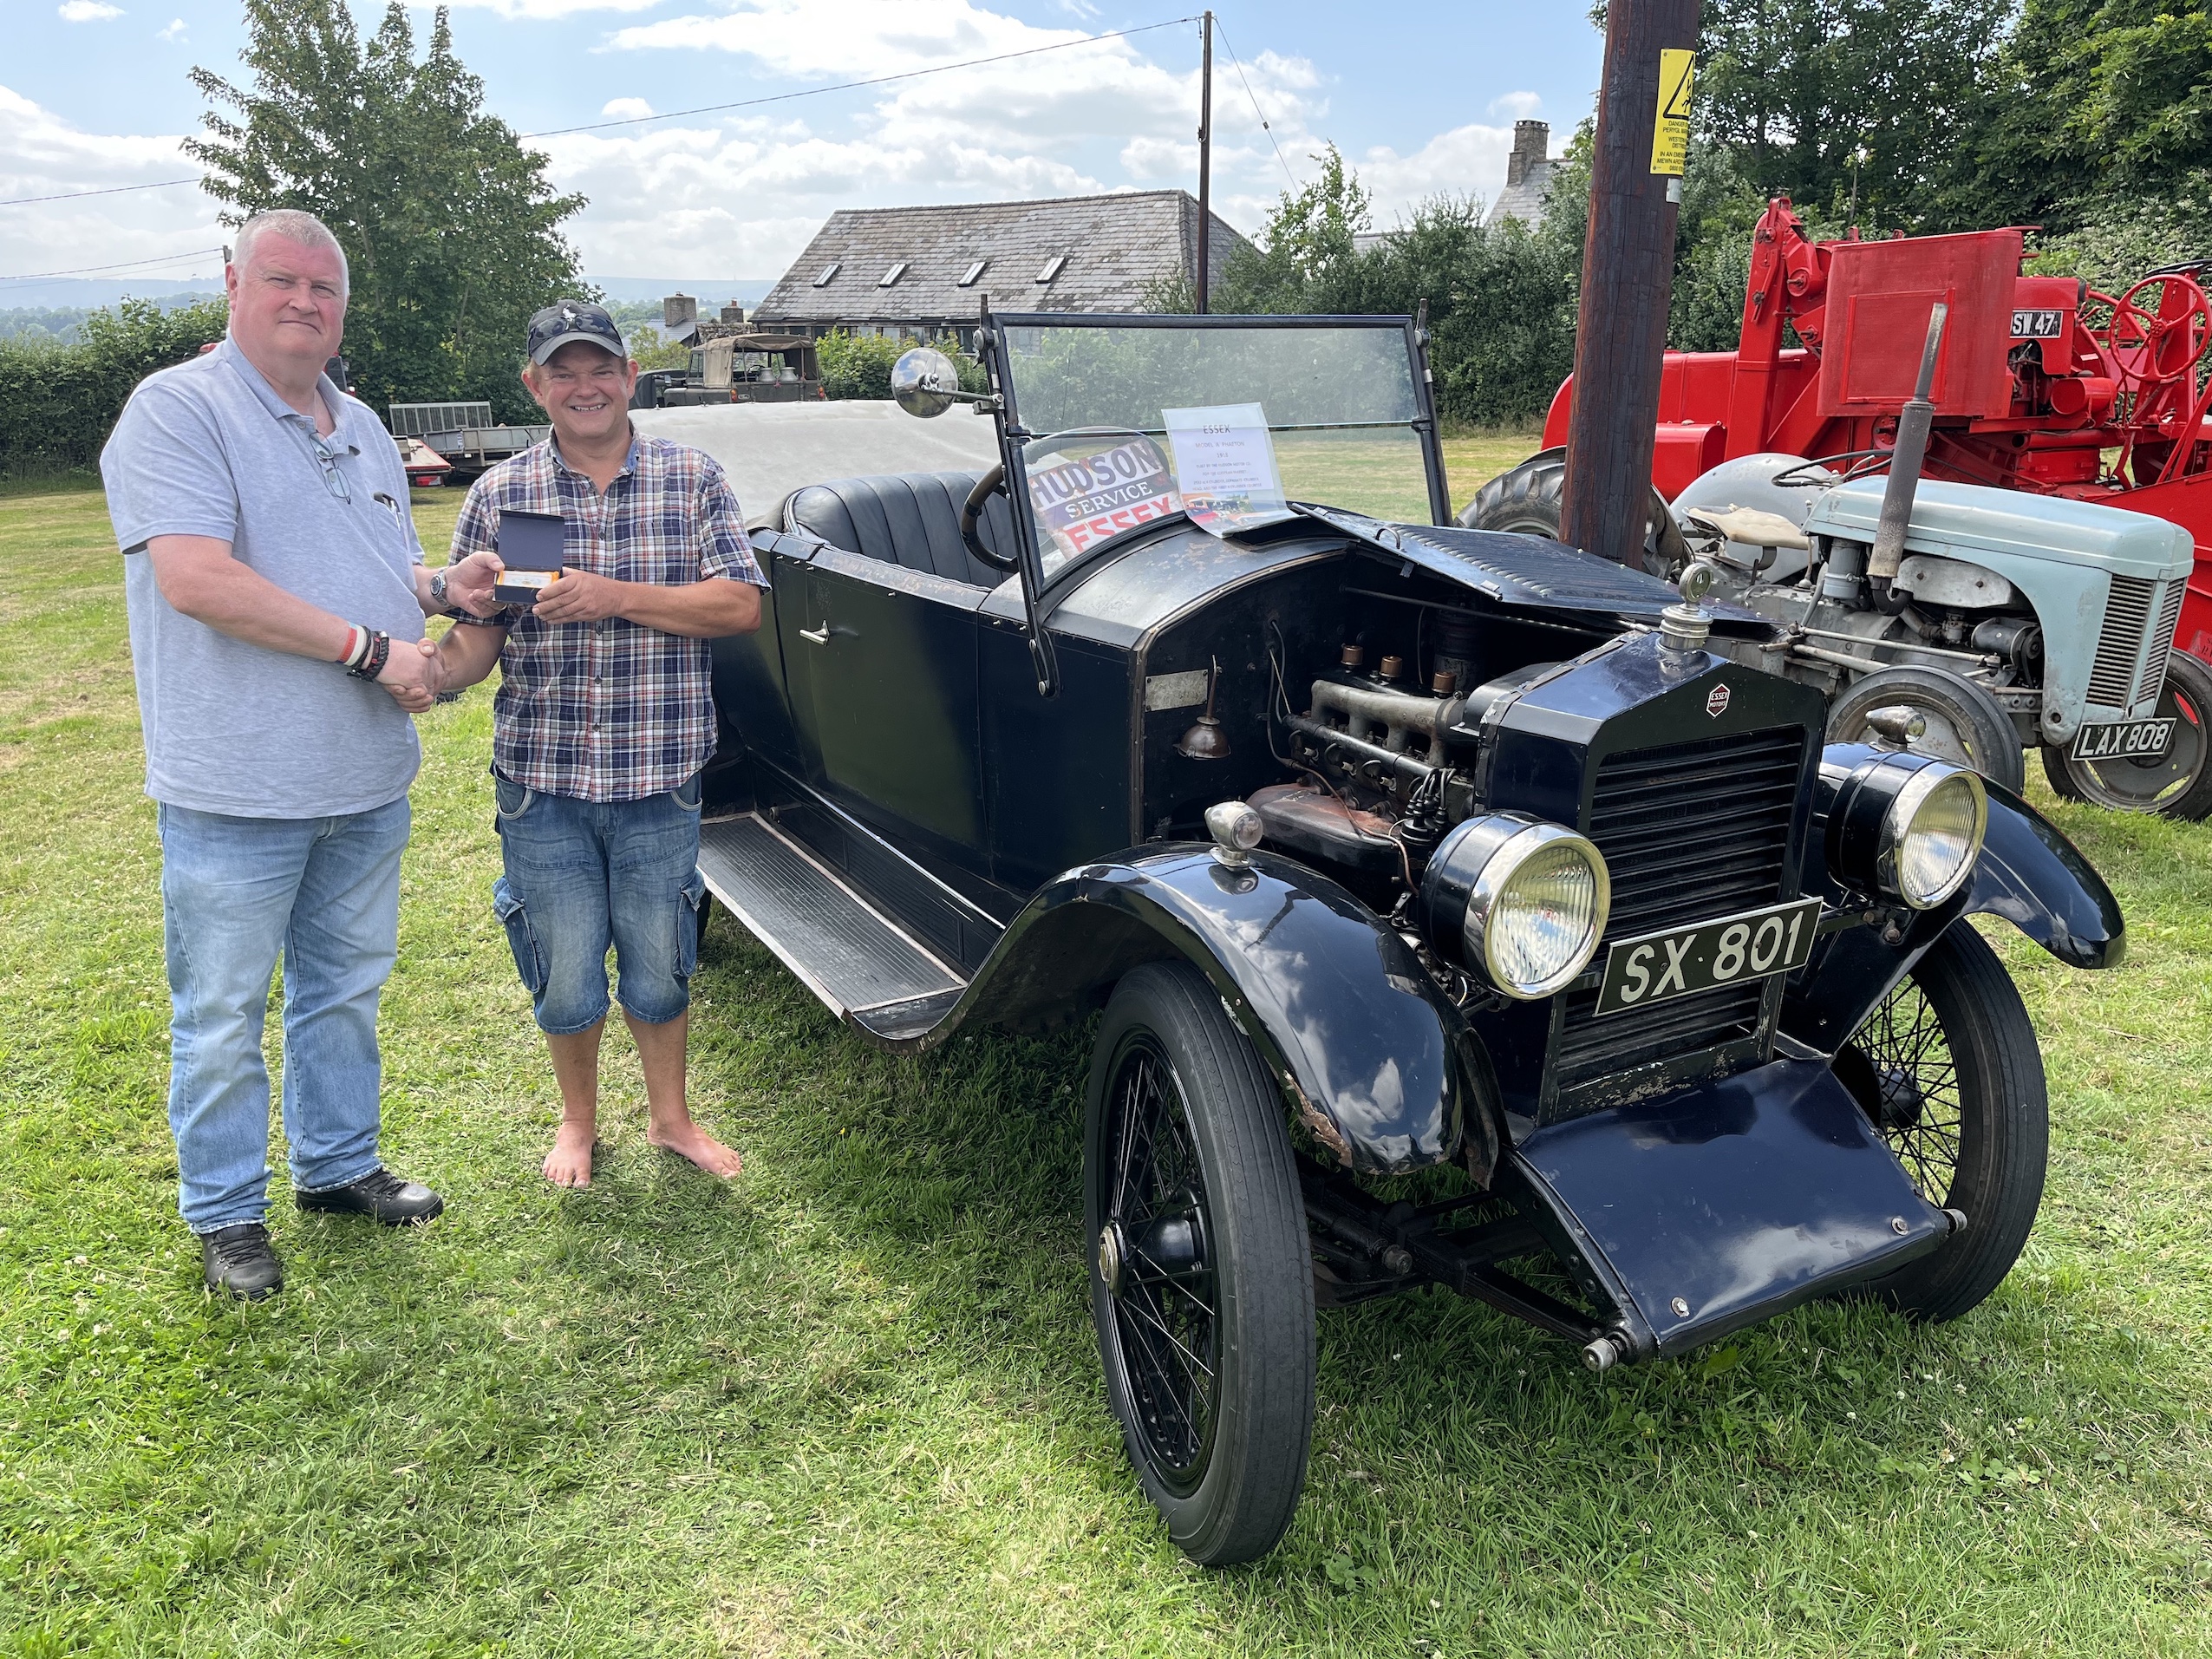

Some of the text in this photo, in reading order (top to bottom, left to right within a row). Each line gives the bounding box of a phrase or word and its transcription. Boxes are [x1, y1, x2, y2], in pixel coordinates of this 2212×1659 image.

[2010, 313, 2033, 335] SW
[1203, 424, 1231, 434] ESSEX
[1030, 443, 1159, 509] HUDSON
[1065, 481, 1153, 519] SERVICE
[1066, 496, 1173, 552] ESSEX
[1711, 692, 1727, 701] ESSEX
[2078, 723, 2170, 756] LAX 808
[1620, 911, 1804, 1003] SX 801
